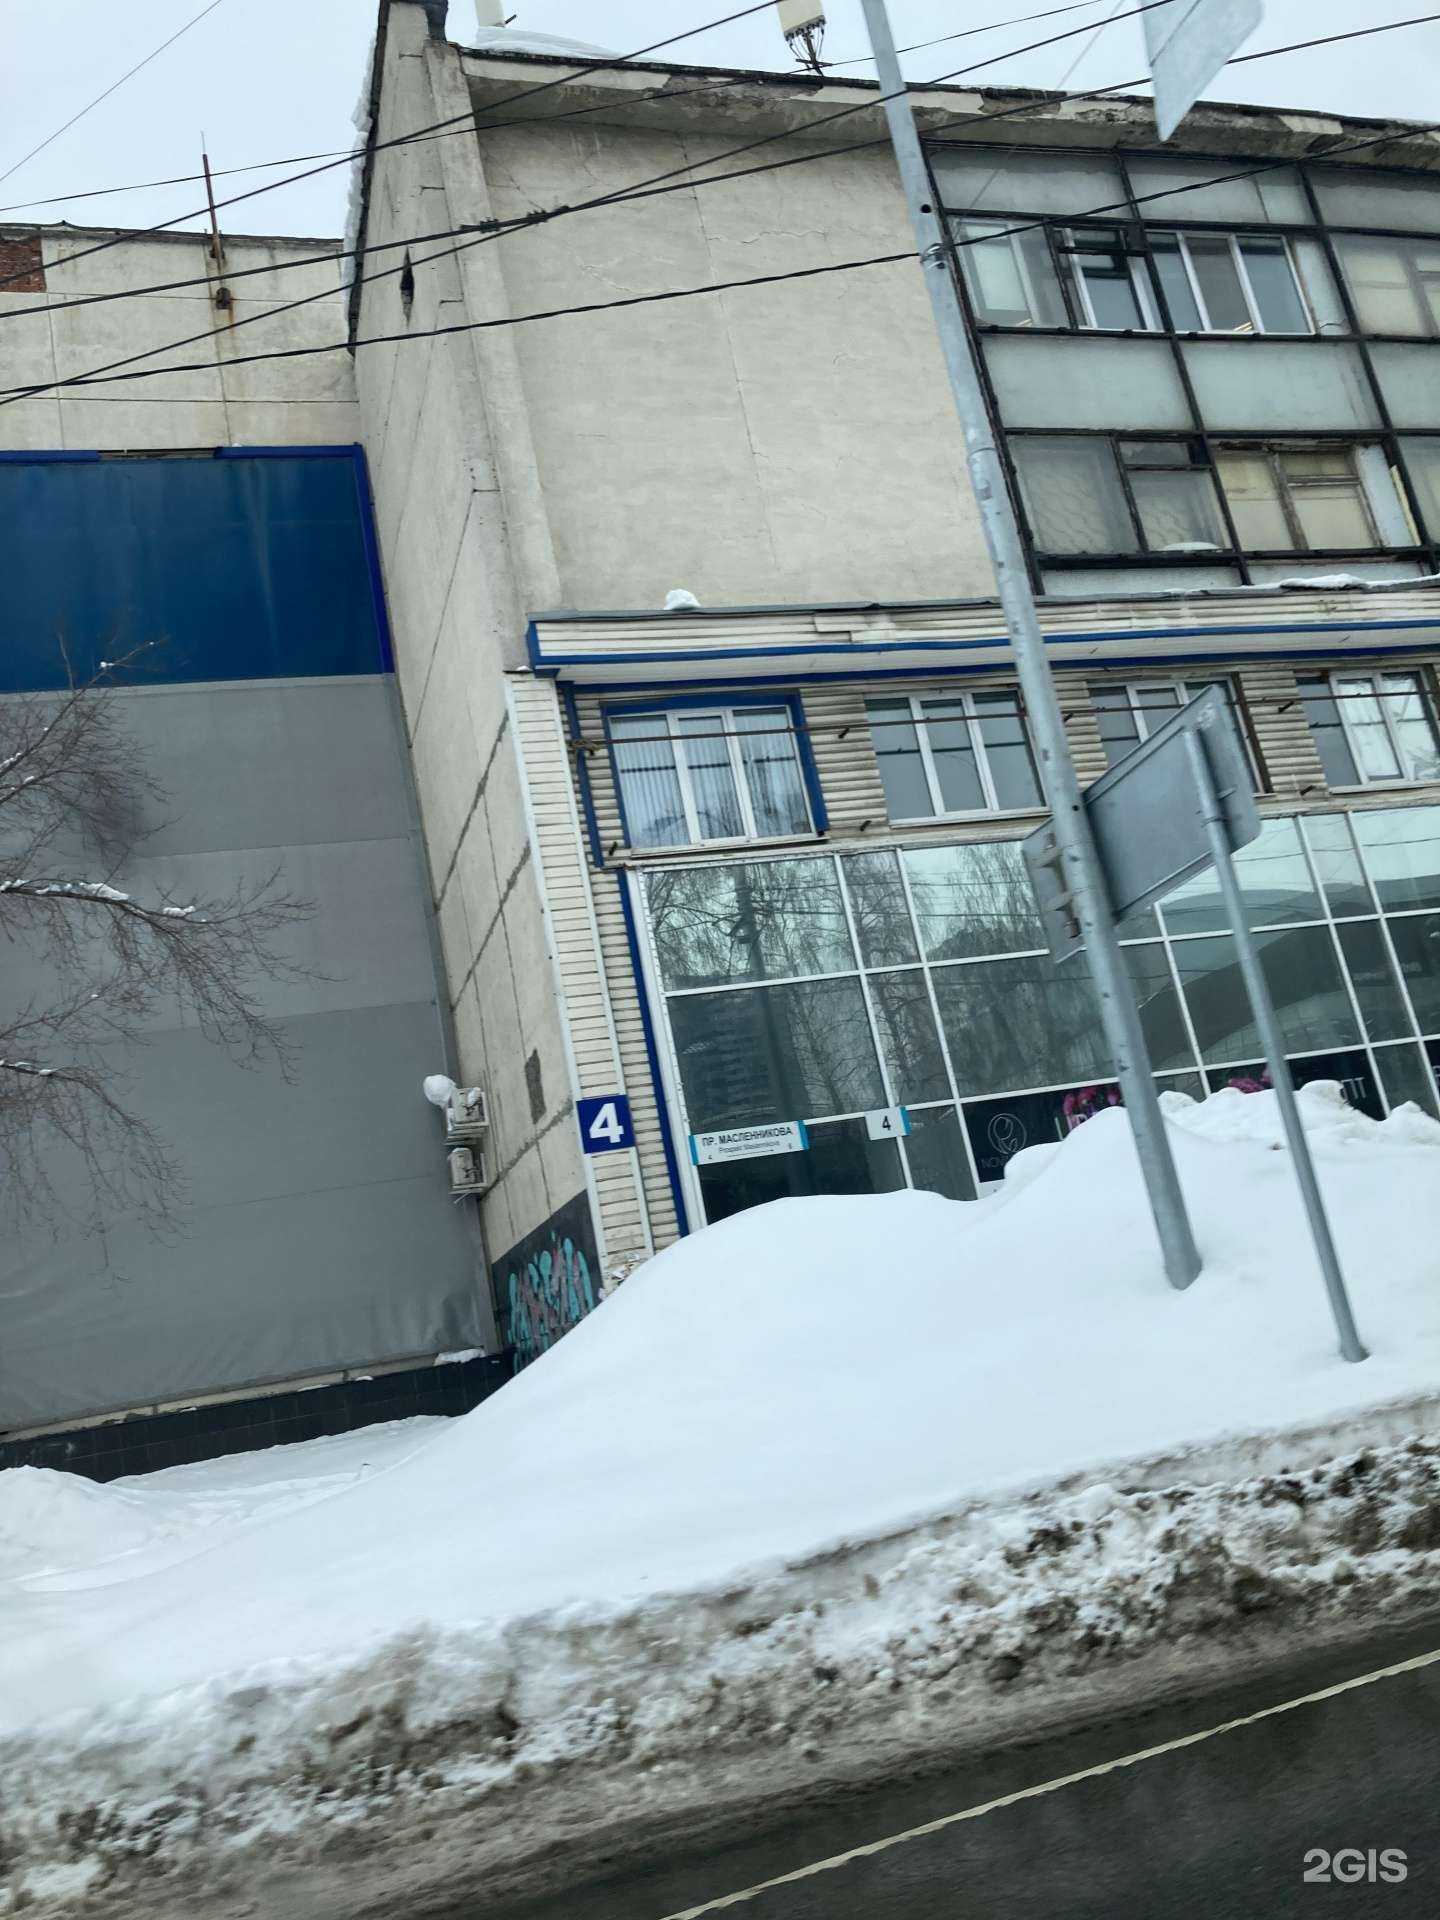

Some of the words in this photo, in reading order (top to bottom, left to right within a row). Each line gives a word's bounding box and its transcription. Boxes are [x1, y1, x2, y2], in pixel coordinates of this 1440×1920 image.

[589, 1102, 624, 1143] 4
[881, 1115, 891, 1131] 4
[702, 1136, 717, 1146] ПР.
[718, 1126, 793, 1145] МАСЛЕННИКОВА
